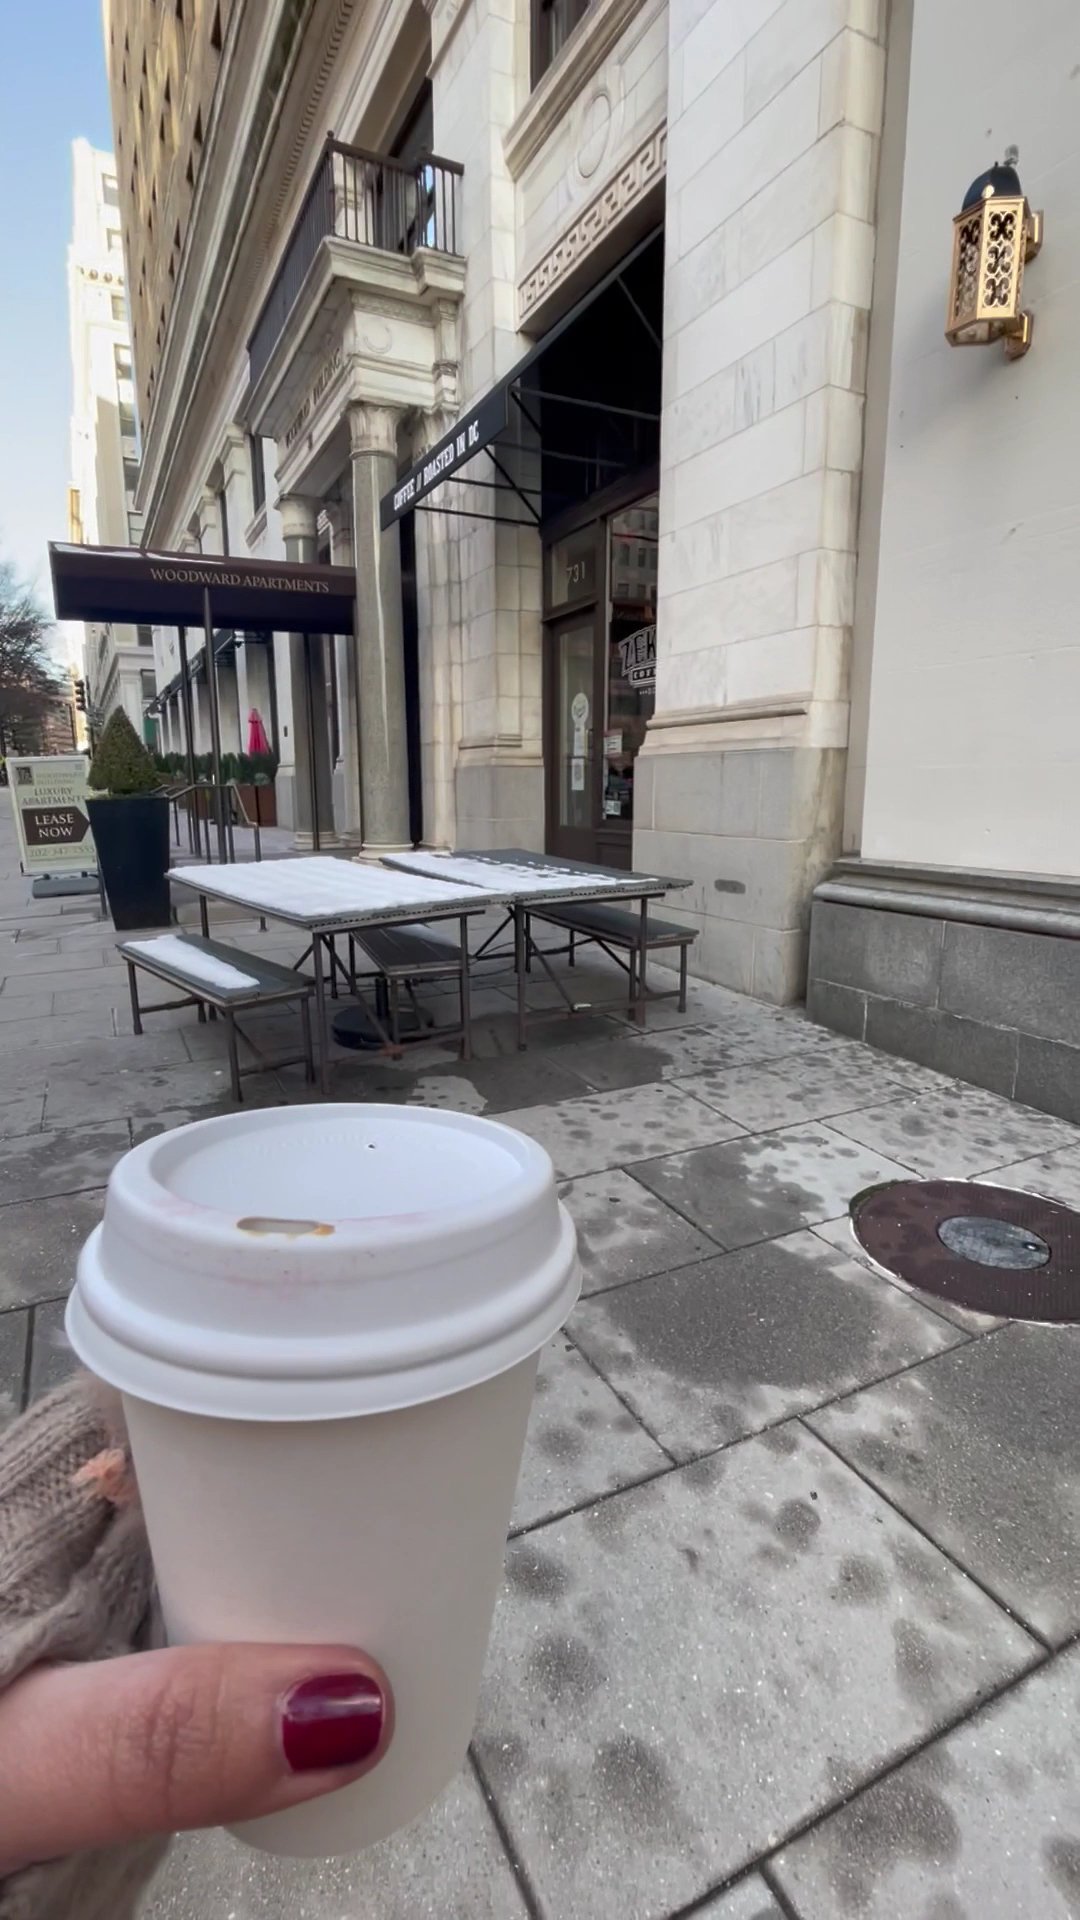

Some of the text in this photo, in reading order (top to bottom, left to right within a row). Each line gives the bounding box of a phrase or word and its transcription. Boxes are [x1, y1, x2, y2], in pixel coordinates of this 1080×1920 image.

[393, 478, 415, 511] COFFEE
[423, 443, 454, 486] ROASTED
[456, 431, 466, 457] IN
[468, 420, 480, 446] DC
[566, 561, 585, 582] 731
[150, 568, 329, 593] WOODWARD APARTMENTS
[34, 787, 73, 796] LUXURY
[35, 813, 75, 825] LEASE
[39, 827, 73, 838] NOW
